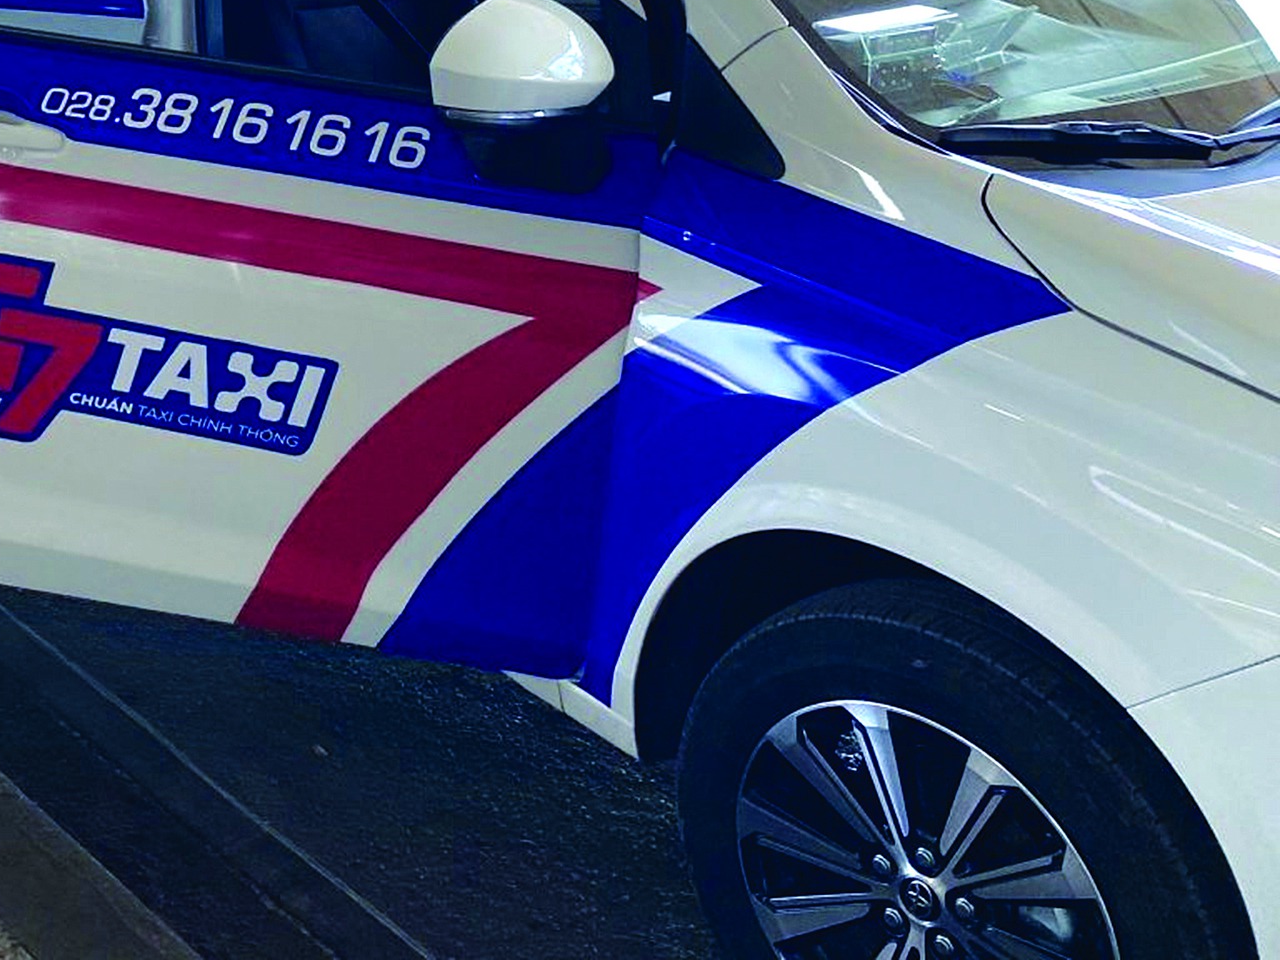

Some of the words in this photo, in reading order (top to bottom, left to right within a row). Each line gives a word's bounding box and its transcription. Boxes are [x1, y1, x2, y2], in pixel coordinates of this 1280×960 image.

[209, 98, 274, 145] 16
[285, 110, 352, 158] 16
[363, 121, 431, 170] 16
[107, 327, 326, 429] TAXI
[138, 405, 174, 423] TAXI
[177, 414, 233, 435] CHÍNH
